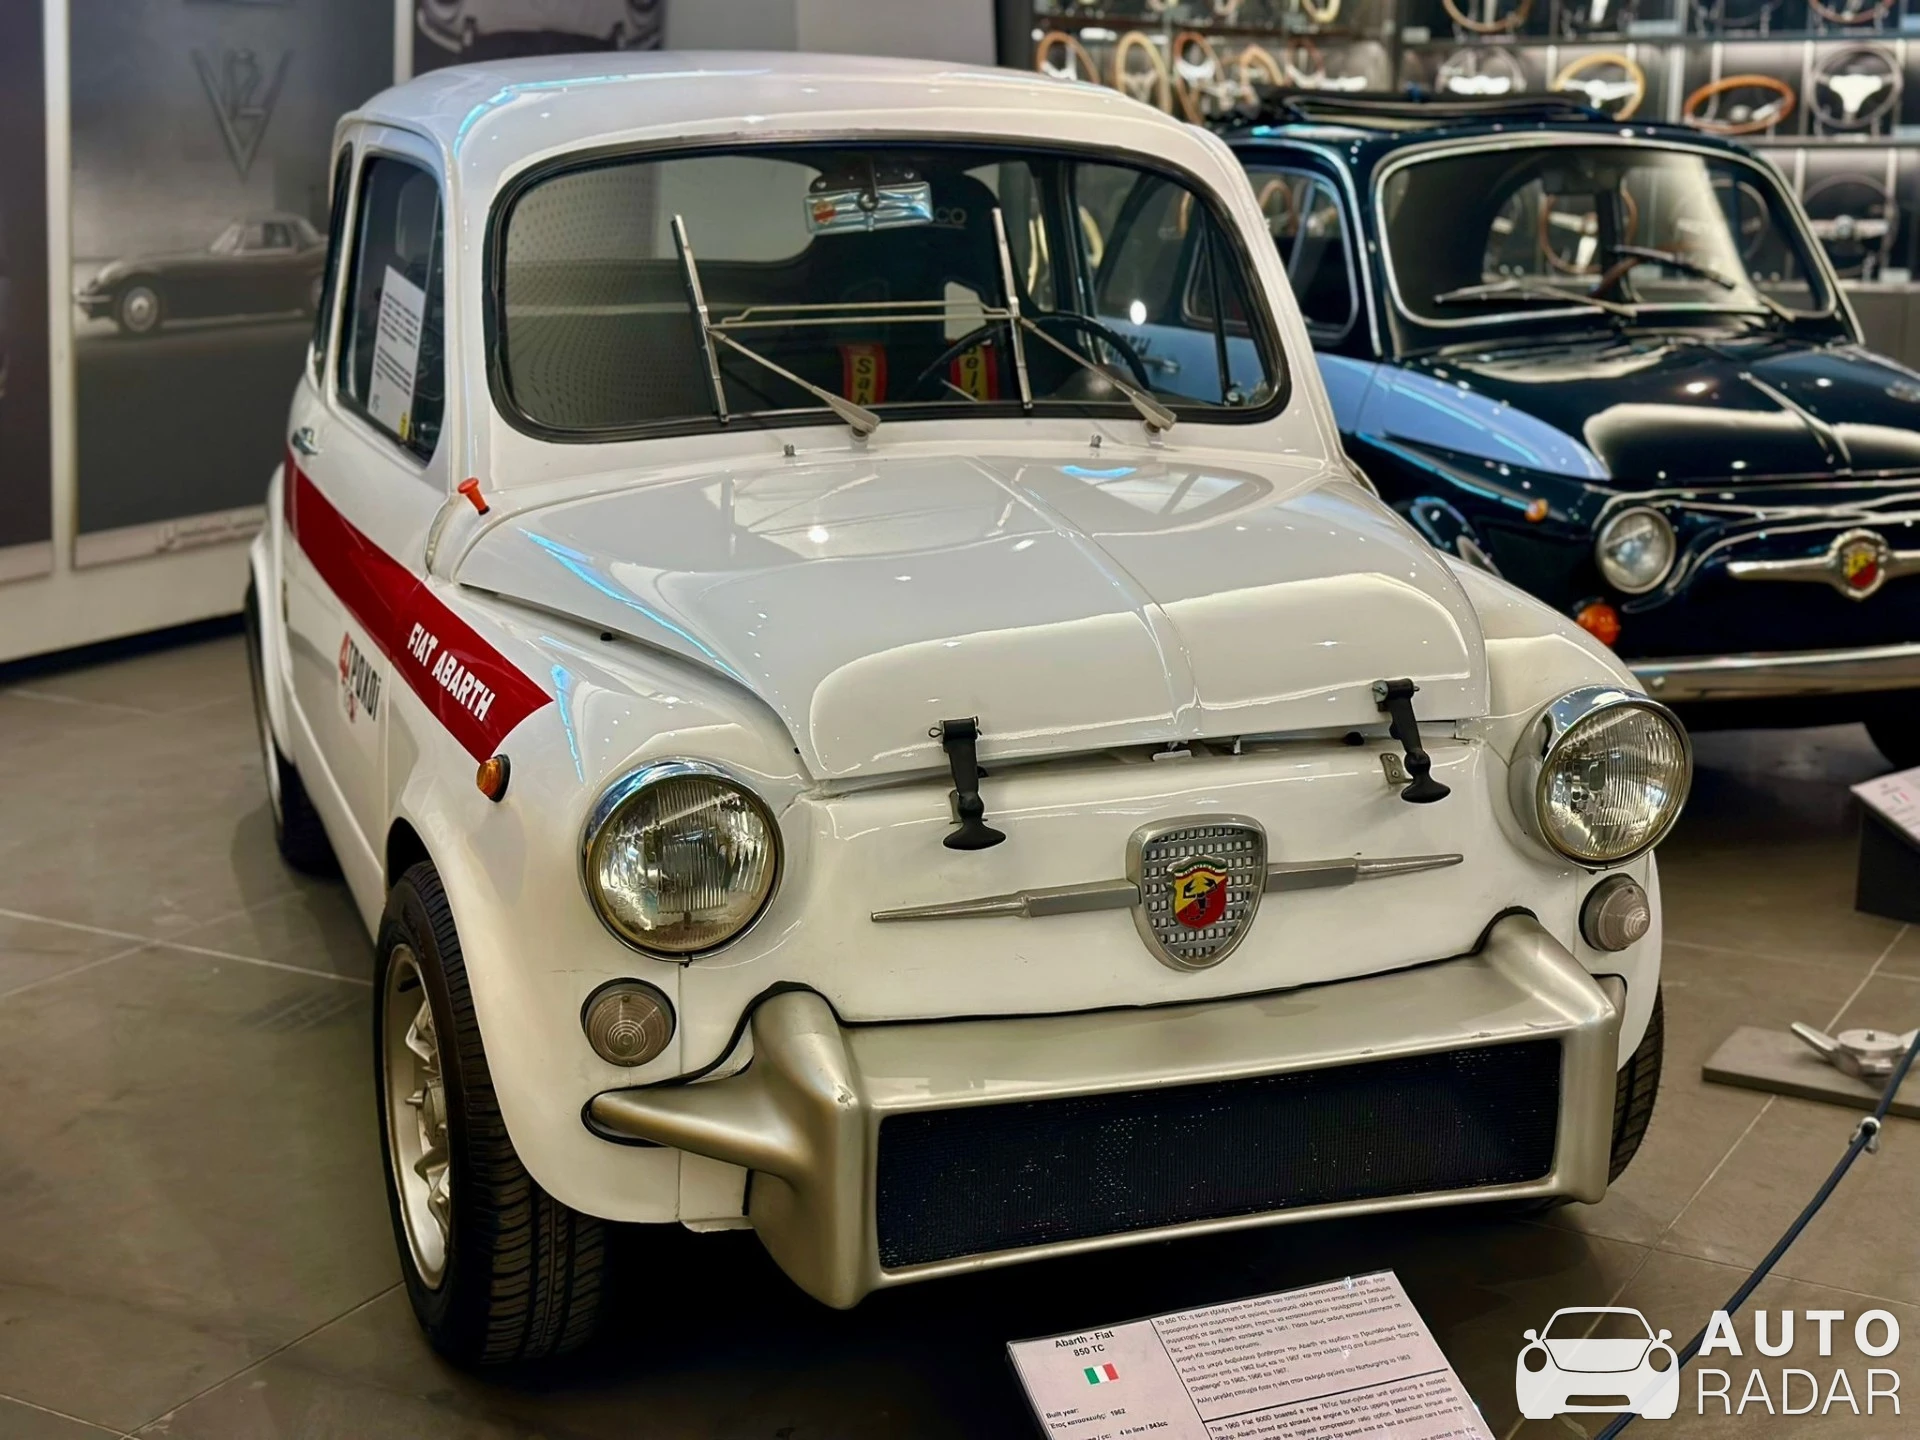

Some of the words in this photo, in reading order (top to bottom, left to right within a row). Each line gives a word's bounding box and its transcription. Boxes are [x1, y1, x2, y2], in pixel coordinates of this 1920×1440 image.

[407, 622, 439, 667] FIAT
[431, 650, 496, 722] ABARTH
[1055, 1336, 1087, 1348] Abarth
[1094, 1330, 1114, 1340] Fiat
[1074, 1347, 1090, 1356] 850
[1091, 1344, 1104, 1352] TC
